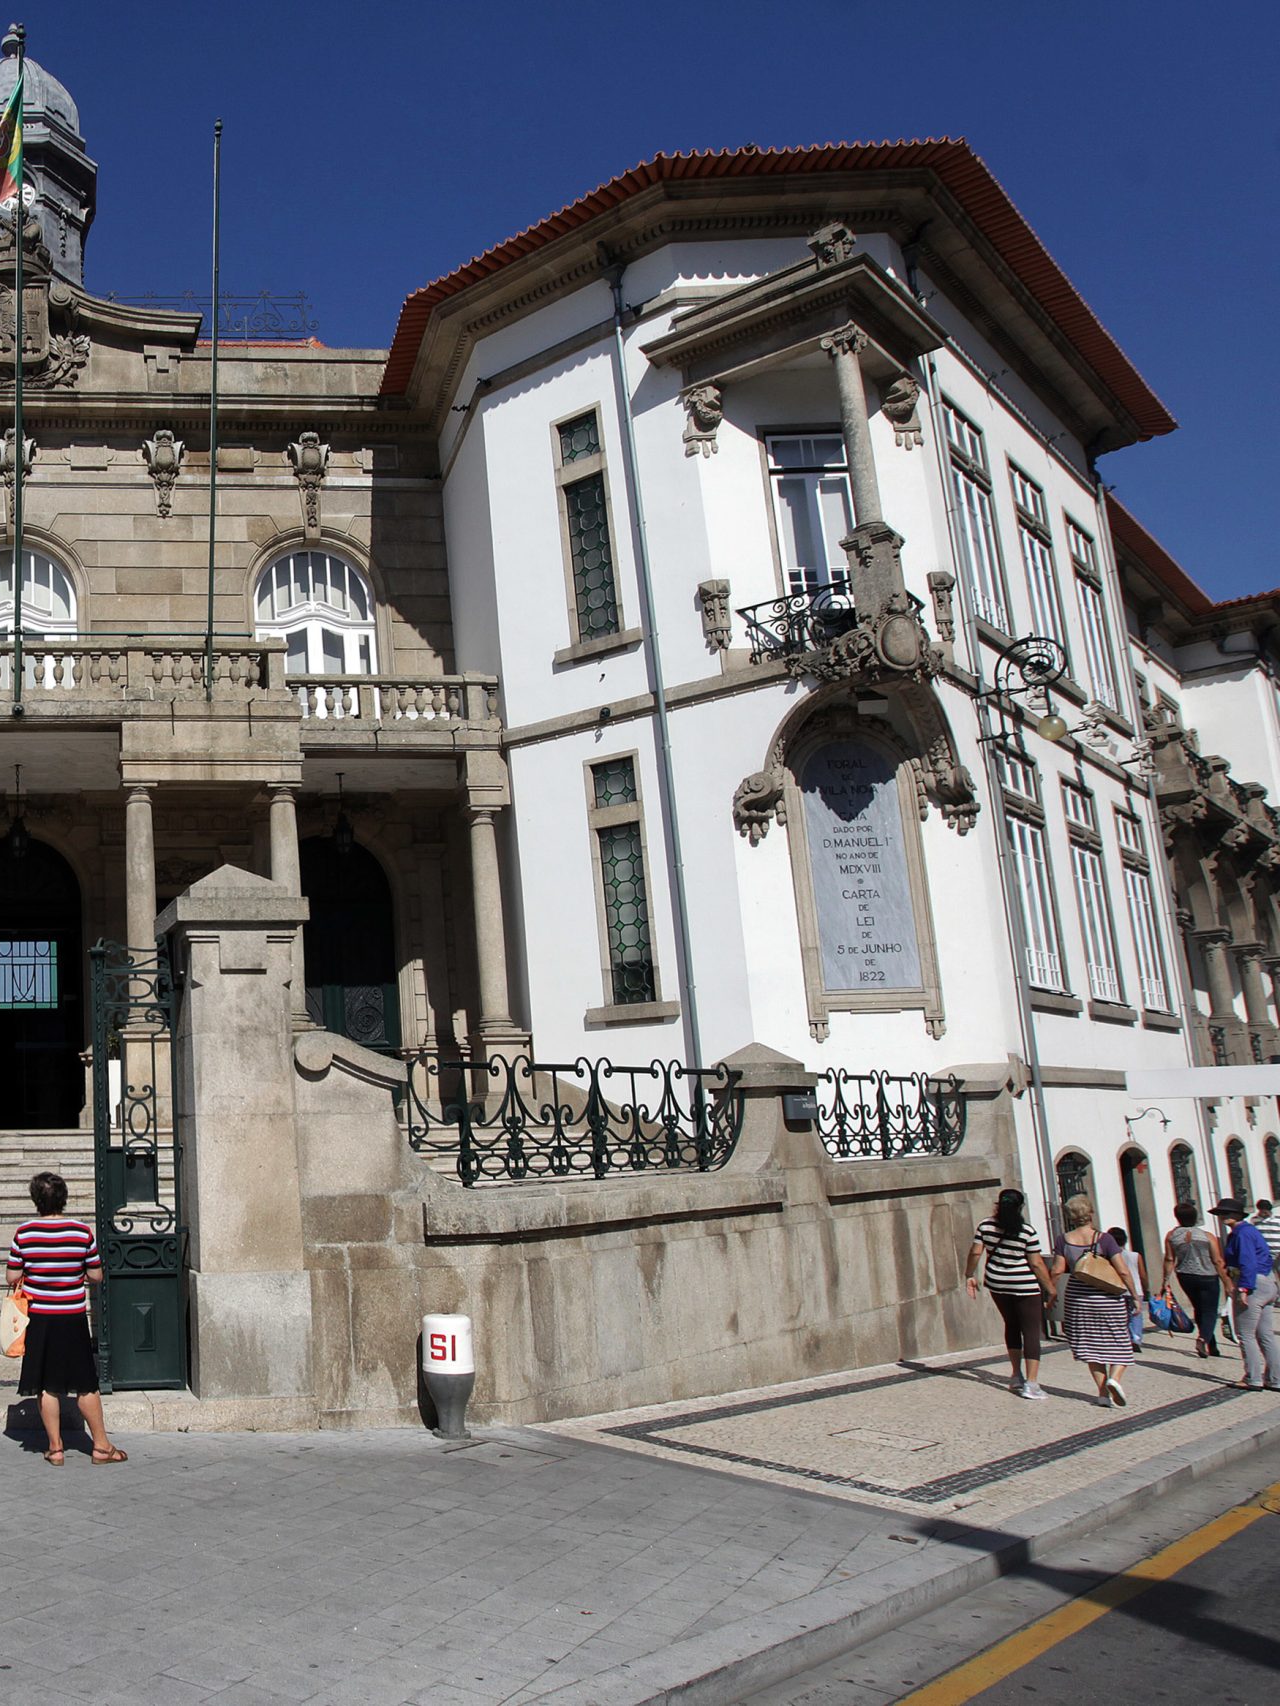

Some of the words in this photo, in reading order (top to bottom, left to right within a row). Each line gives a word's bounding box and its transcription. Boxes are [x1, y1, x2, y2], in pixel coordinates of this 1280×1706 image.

[857, 825, 873, 833] POR
[849, 852, 867, 860] ANO
[839, 864, 881, 874] MDXVIII
[842, 889, 880, 899] CARTA
[856, 916, 875, 926] LEI
[862, 931, 872, 939] DE
[837, 945, 845, 954] 5
[861, 943, 902, 954] JUNHO
[859, 971, 885, 982] 1822
